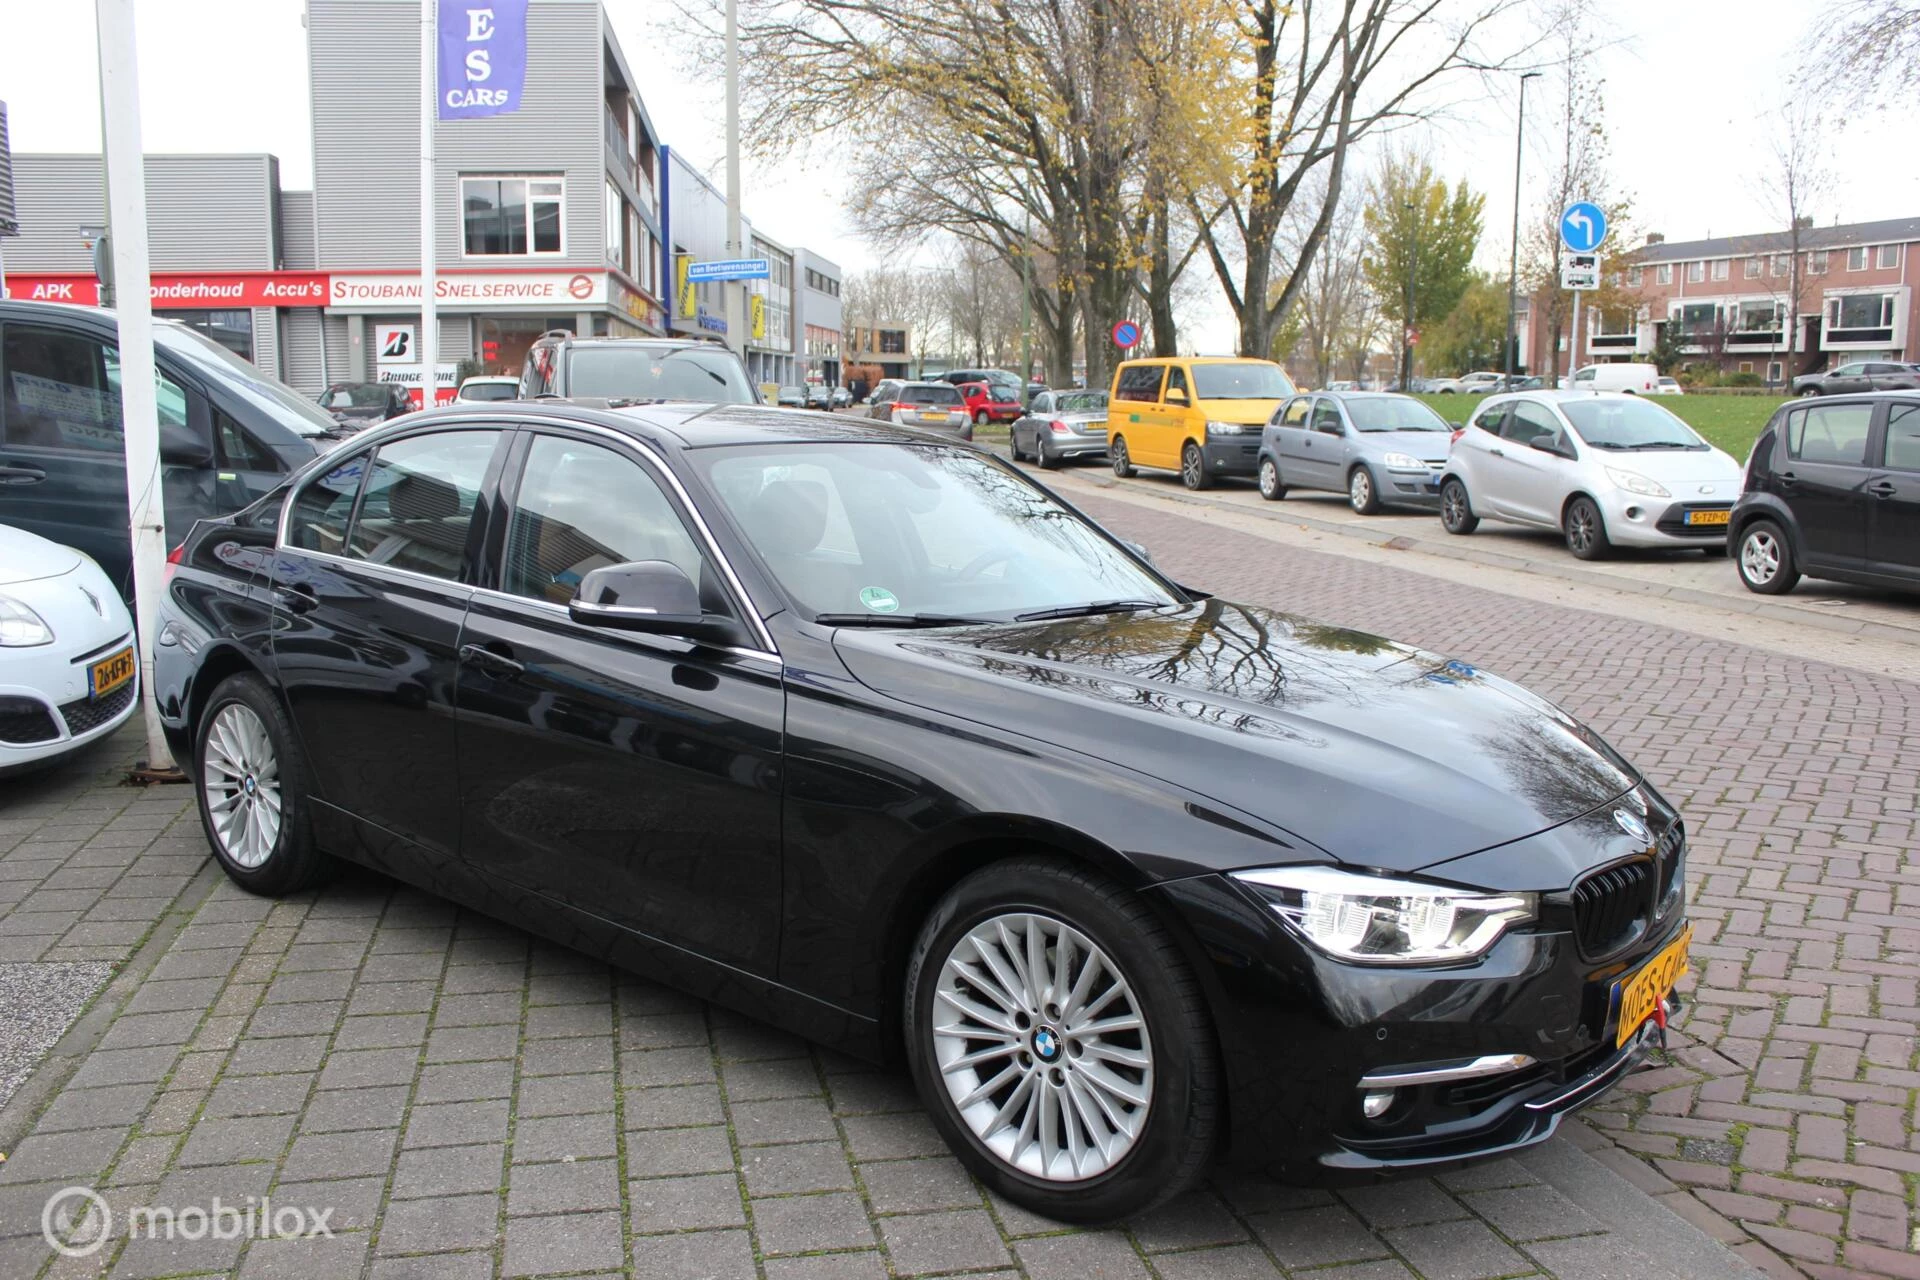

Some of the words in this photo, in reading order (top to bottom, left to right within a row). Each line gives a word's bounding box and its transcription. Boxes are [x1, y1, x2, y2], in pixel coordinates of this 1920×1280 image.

[446, 88, 508, 108] CARS
[32, 283, 73, 299] APK
[149, 282, 244, 298] onderhoud
[262, 281, 323, 297] Accu's
[333, 281, 422, 298] STOUBAN
[434, 280, 554, 298] SNELSERVICE
